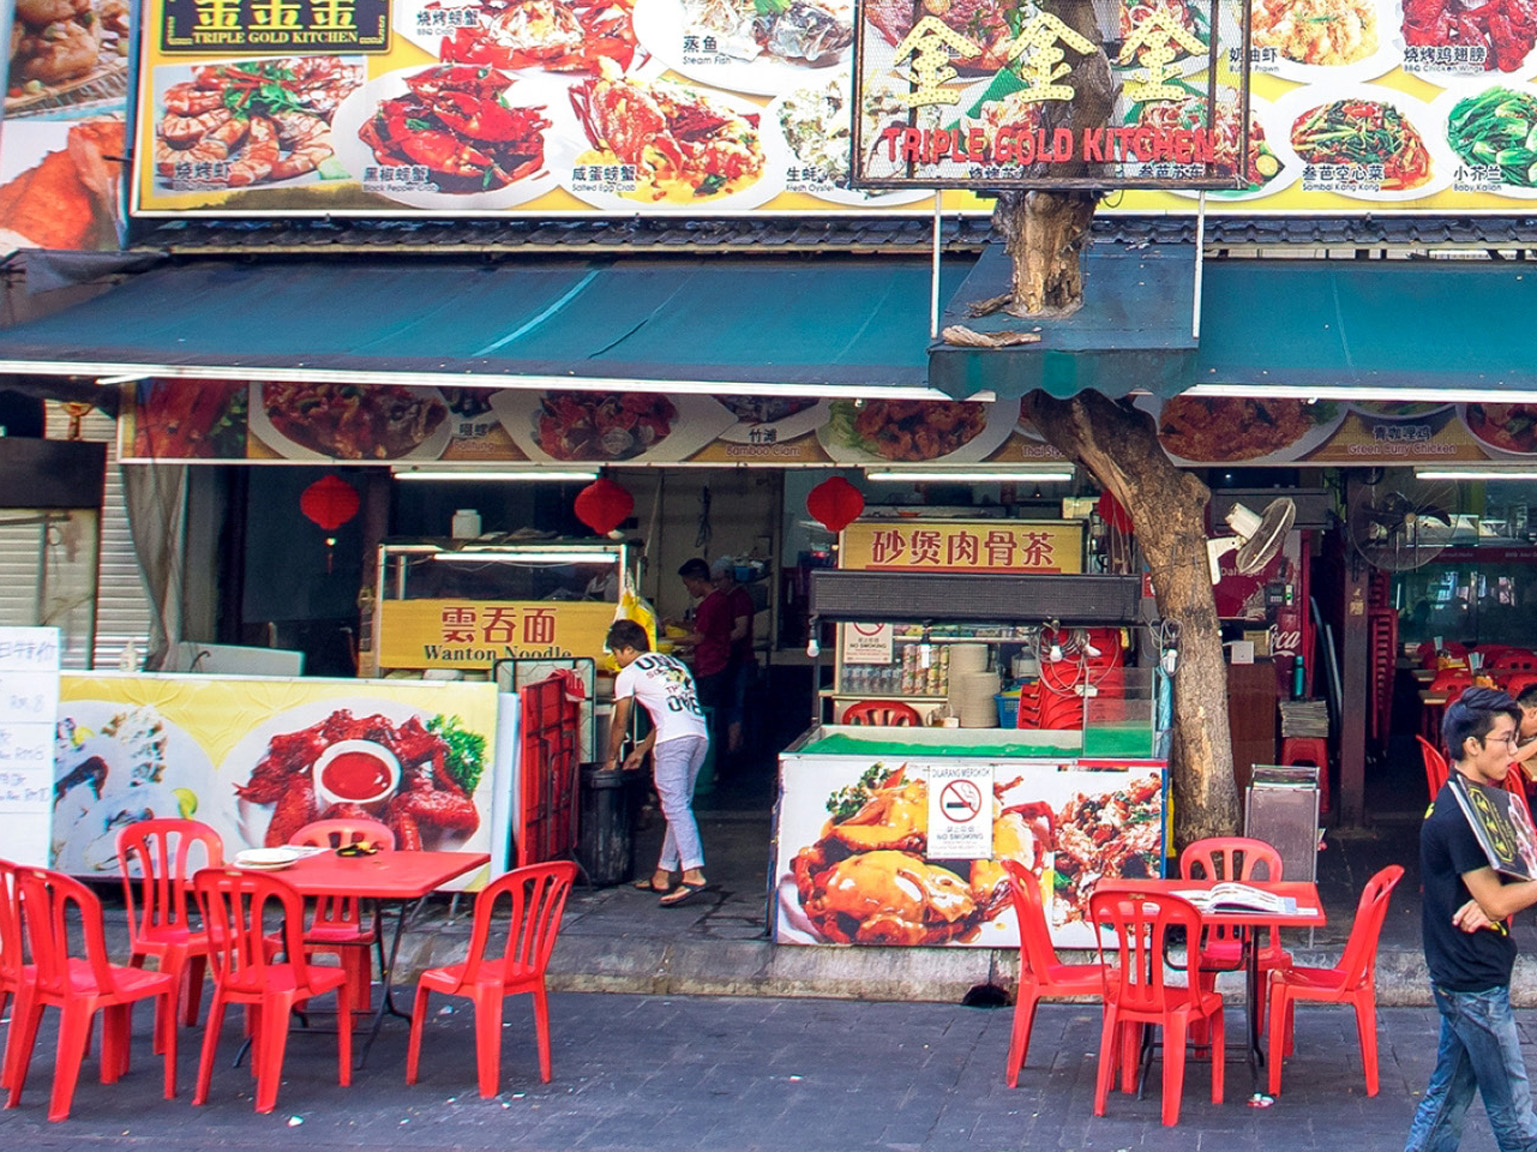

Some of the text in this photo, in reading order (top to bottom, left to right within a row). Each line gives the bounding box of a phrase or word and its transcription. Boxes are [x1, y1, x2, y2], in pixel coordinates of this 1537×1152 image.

[193, 31, 358, 44] TRIPLE GOLD KITCHEN
[683, 35, 718, 54] 蒸鱼
[683, 55, 732, 65] Steam Fish
[1423, 64, 1457, 73] Chicken
[1458, 64, 1484, 74] Wings
[882, 127, 1216, 166] TRIPLE GOLD KITCHEN
[572, 183, 636, 195] Salted Egg Crab
[786, 183, 835, 194] Fresh Oyster
[1302, 182, 1380, 193] Sambal Kang Kong
[1453, 182, 1502, 193] Baby Kailan
[726, 445, 800, 456] Bamboo Clam
[1349, 444, 1380, 454] Green
[1413, 443, 1456, 454] Chicken
[872, 529, 1055, 566] 砂煲肉骨茶
[442, 606, 557, 644] 雲吞面
[424, 645, 573, 661] Wanton Noodle
